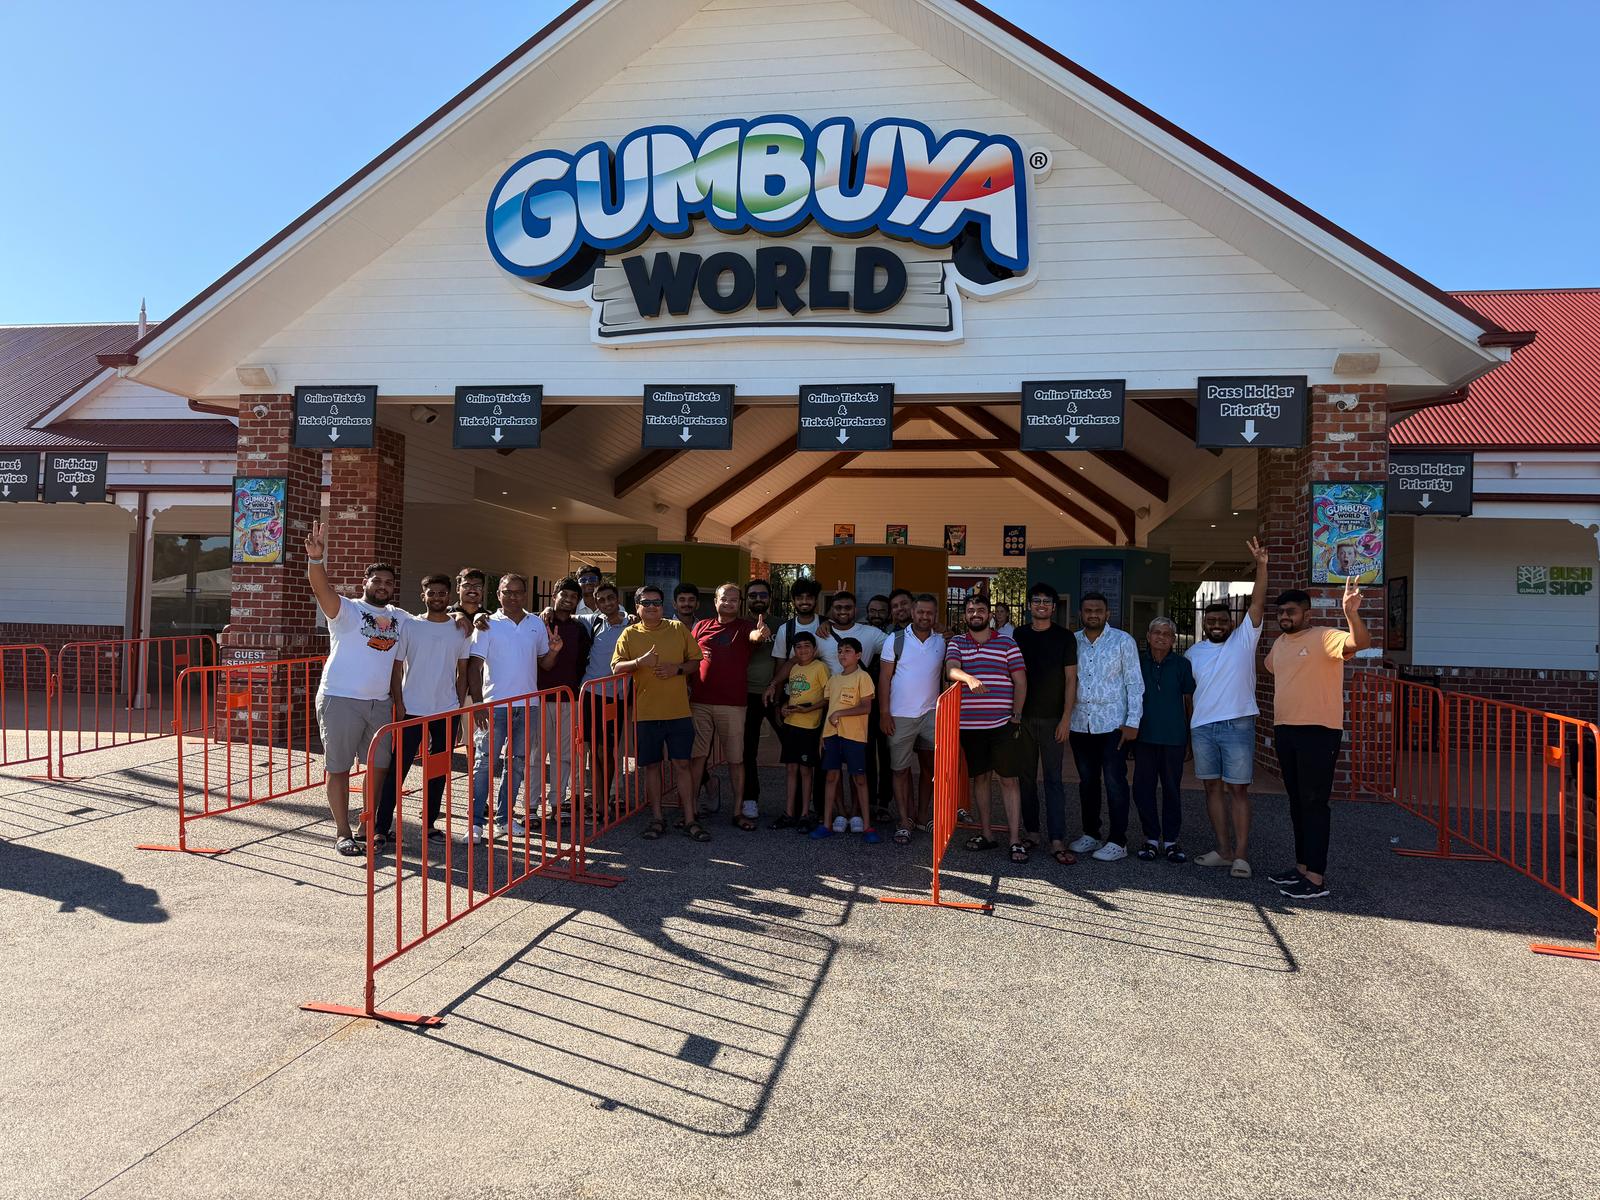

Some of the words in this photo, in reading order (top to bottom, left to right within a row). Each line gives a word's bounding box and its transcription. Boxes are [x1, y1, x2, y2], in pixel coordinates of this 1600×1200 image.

[487, 115, 1028, 276] GUMBUYA
[621, 246, 907, 318] WORLD
[653, 392, 683, 402] Online
[684, 392, 720, 402] Tickets
[808, 394, 840, 403] Online
[841, 392, 878, 402] Tickets
[1034, 390, 1069, 400] Online
[1070, 389, 1111, 399] Tickets
[1208, 386, 1243, 398] Pass
[1245, 385, 1294, 399] Holder
[304, 394, 332, 403] Online
[333, 394, 365, 403] Tickets
[466, 394, 496, 403] Online
[496, 393, 530, 403] Tickets
[330, 405, 338, 414] &
[493, 405, 502, 415] &
[681, 404, 691, 414] &
[838, 405, 847, 415] &
[1067, 402, 1077, 413] &
[1221, 403, 1280, 419] Priority
[298, 416, 326, 425] Ticket
[327, 416, 372, 425] Purchases
[460, 416, 489, 426] Ticket
[490, 416, 537, 425] Purchases
[646, 415, 677, 425] Ticket
[678, 416, 727, 425] Purchases
[801, 417, 833, 427] Ticket
[834, 417, 886, 427] Purchases
[1027, 415, 1061, 425] Ticket
[1064, 415, 1119, 425] Purchases
[54, 458, 97, 471] Birthday
[1389, 463, 1419, 474] Pass
[1421, 463, 1465, 476] Holder
[58, 472, 95, 483] Parties
[1400, 478, 1452, 492] Priority
[1326, 504, 1369, 515] GUMBUYA
[1550, 567, 1592, 580] BUSH
[1550, 582, 1592, 595] SHOP
